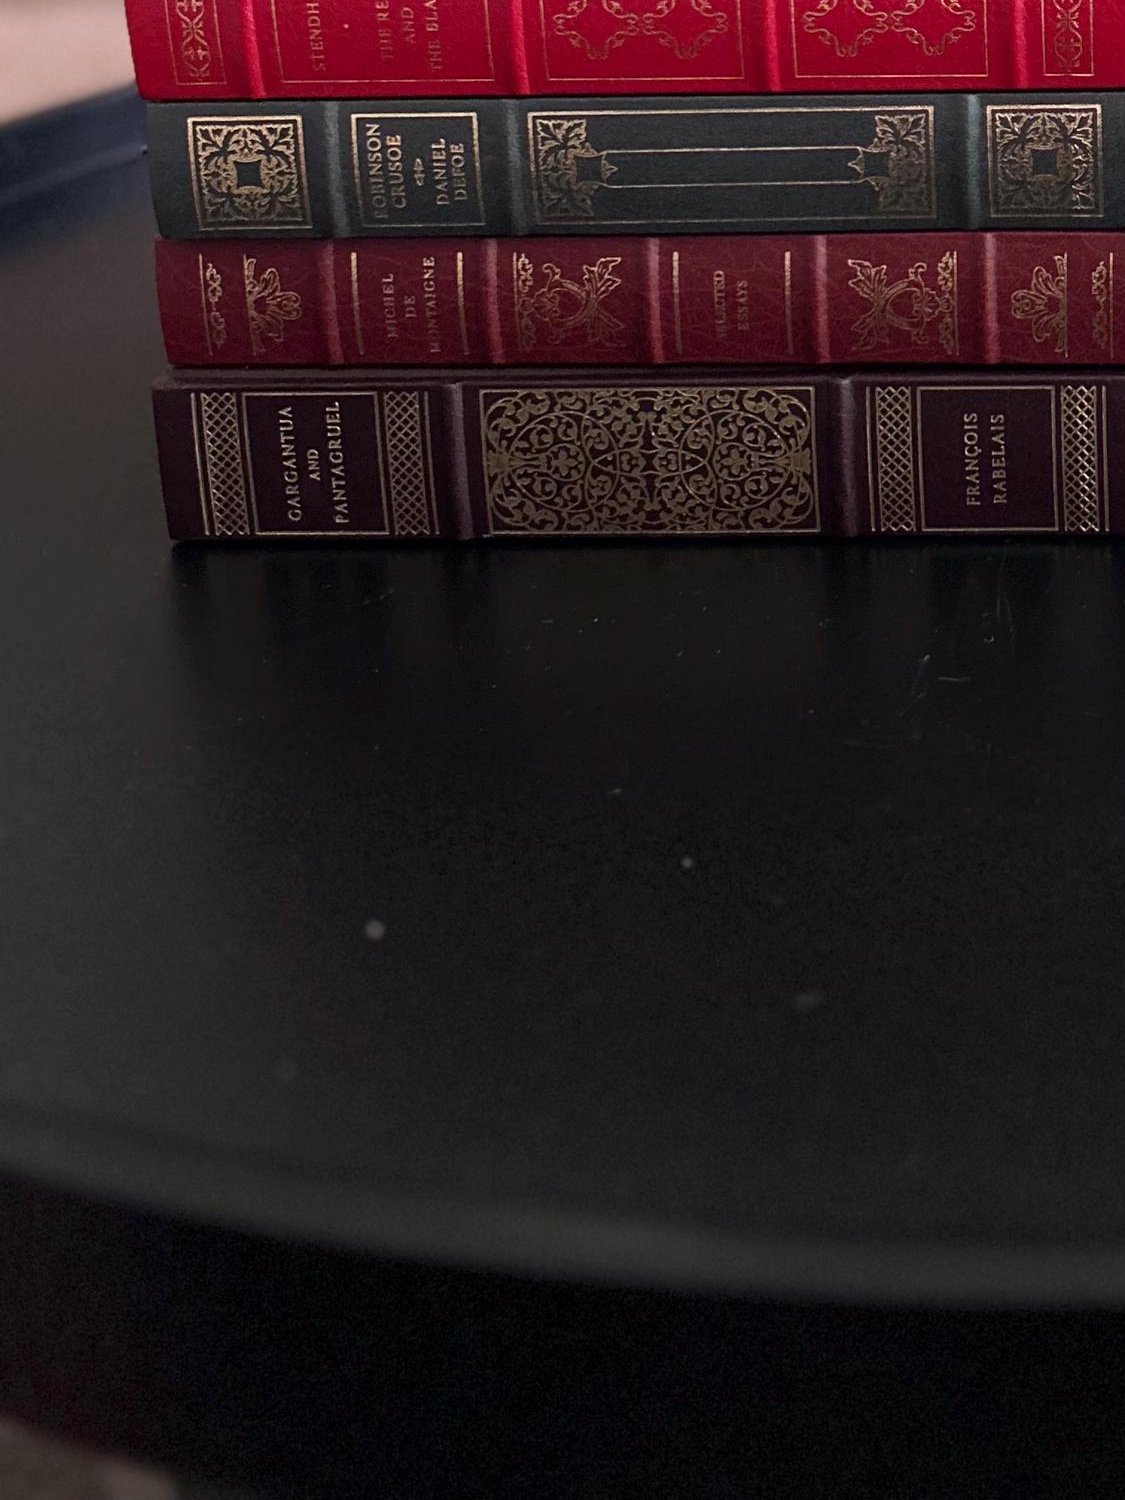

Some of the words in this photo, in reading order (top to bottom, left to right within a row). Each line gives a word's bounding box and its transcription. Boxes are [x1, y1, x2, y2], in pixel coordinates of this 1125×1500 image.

[378, 28, 394, 62] THE
[401, 6, 417, 44] AND
[427, 39, 442, 72] THE
[366, 123, 388, 219] ROBINSON
[386, 134, 407, 209] CRUSOE
[432, 138, 450, 205] DANIEL
[450, 143, 467, 200] DEFOE
[382, 273, 399, 338] MICHEL
[404, 295, 417, 318] DE
[422, 256, 442, 353] MONTAIGNE
[736, 280, 749, 331] ESSAYS
[278, 405, 302, 522] GARGANTUA
[306, 448, 321, 482] AND
[325, 401, 350, 524] PANTAGRUEL
[963, 412, 983, 506] FRANÇOIS
[990, 413, 1008, 504] RABELAIS
